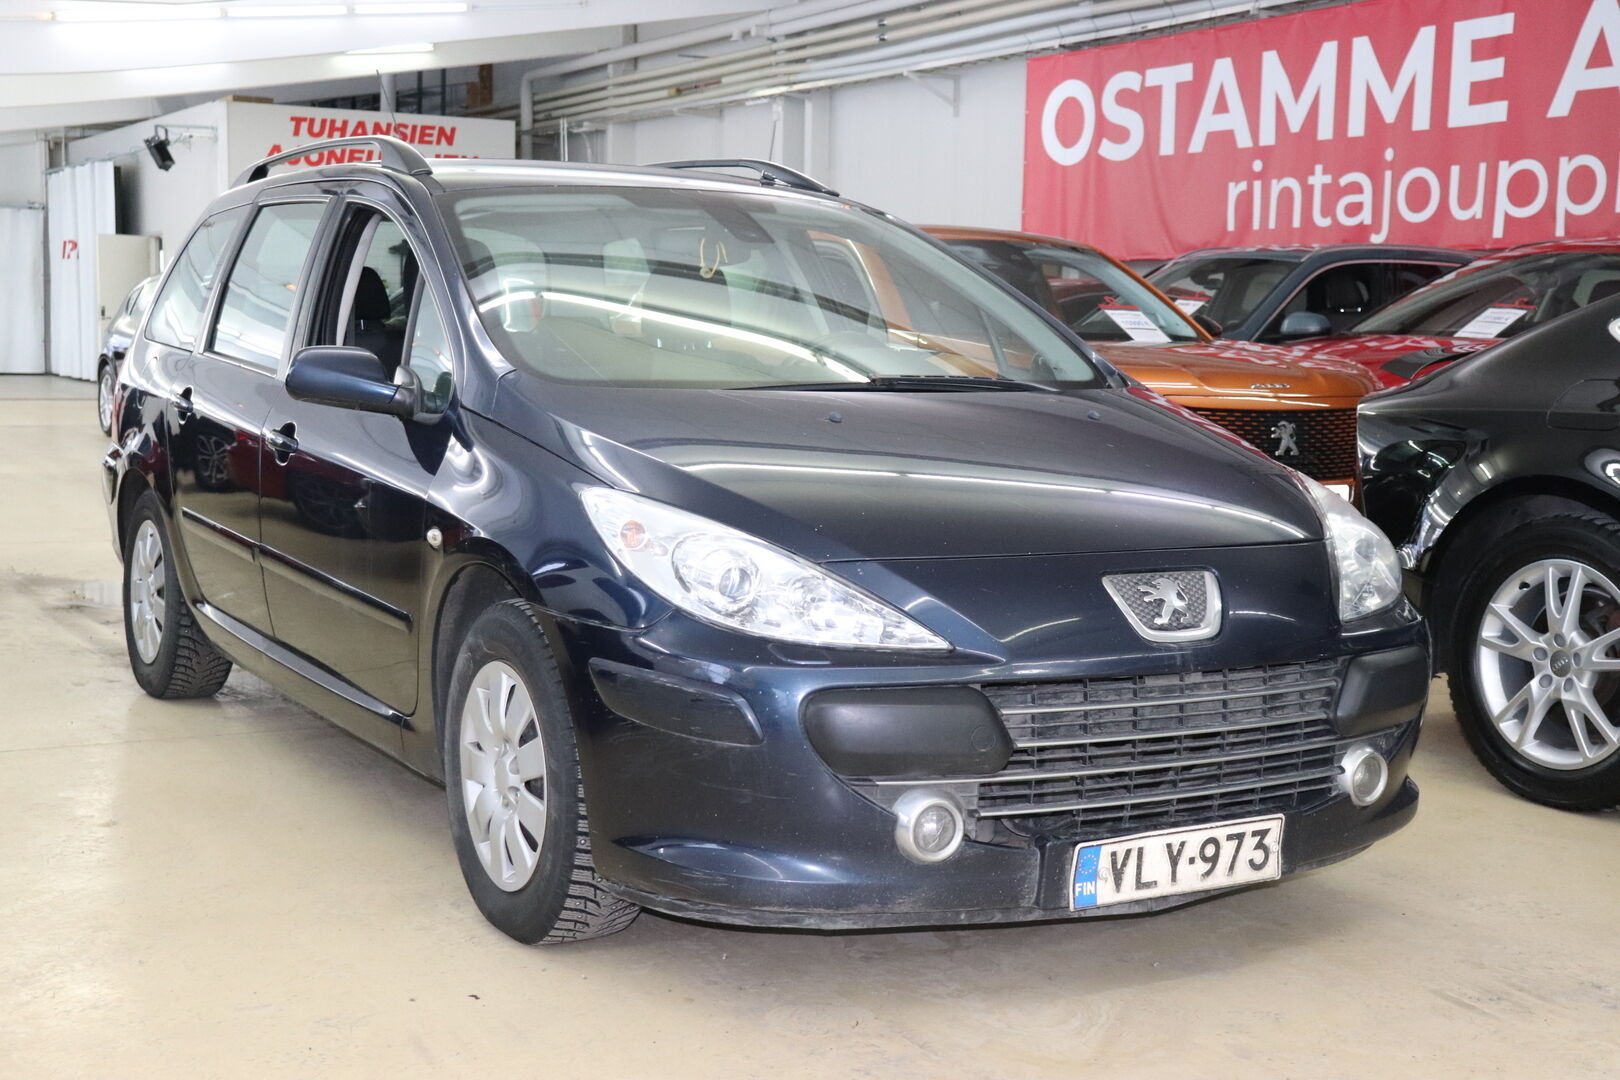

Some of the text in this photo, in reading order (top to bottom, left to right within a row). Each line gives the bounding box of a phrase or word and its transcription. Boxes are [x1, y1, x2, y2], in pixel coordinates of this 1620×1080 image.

[1041, 13, 1515, 167] OSTAMME
[290, 116, 457, 146] TUHANSIEN
[1110, 827, 1272, 894] VLY-973
[1075, 881, 1096, 898] FIN
